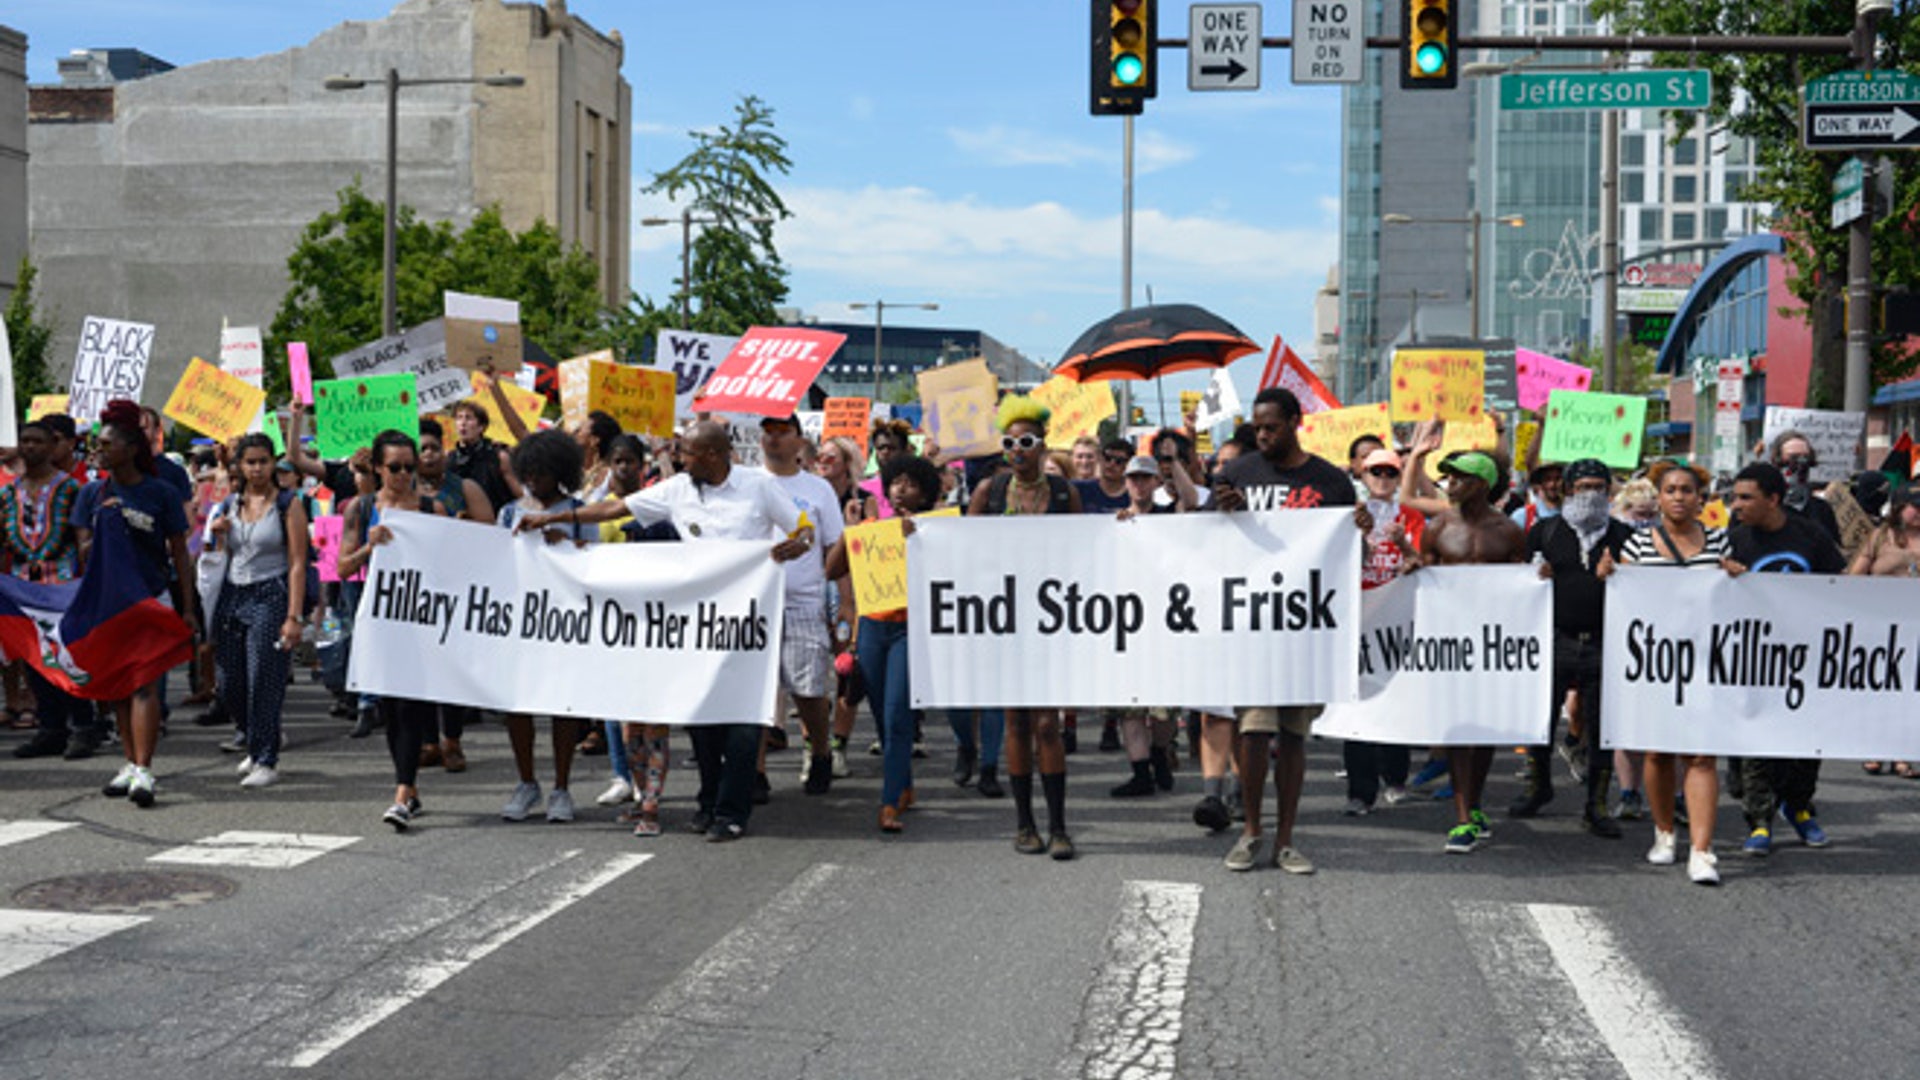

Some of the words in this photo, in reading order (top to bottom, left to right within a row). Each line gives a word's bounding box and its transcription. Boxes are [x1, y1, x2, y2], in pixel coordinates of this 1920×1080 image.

[1203, 11, 1248, 31] ONE
[1311, 4, 1347, 23] NO
[1201, 35, 1249, 53] WAY
[1308, 28, 1350, 40] TURN
[1315, 46, 1340, 59] ON
[1311, 63, 1344, 77] RED
[1515, 76, 1651, 104] Jefferson
[1665, 77, 1696, 100] St
[1812, 82, 1906, 100] JEFFERSON
[1817, 117, 1850, 133] ONE
[1857, 117, 1894, 131] WAY
[82, 321, 155, 360] BLACK
[670, 336, 710, 360] WE
[738, 338, 820, 362] SHUT.
[351, 339, 411, 373] BLACK
[746, 356, 782, 378] IT.
[75, 353, 141, 392] LIVES
[417, 379, 463, 404] TTER
[706, 375, 798, 401] DOWN.
[372, 569, 457, 643] Hillary
[465, 585, 512, 636] Has
[521, 590, 592, 644] Blood
[602, 599, 636, 647] On
[645, 602, 688, 649] Her
[697, 599, 767, 651] Hands
[930, 575, 1016, 634] End
[1038, 579, 1143, 652] Stop
[1165, 583, 1198, 633] &
[1222, 569, 1337, 631] Frisk
[1375, 621, 1473, 671] Welcome
[1483, 624, 1540, 671] Here
[1625, 619, 1695, 705] Stop
[1709, 619, 1809, 709] Killing
[1818, 623, 1905, 691] Black
